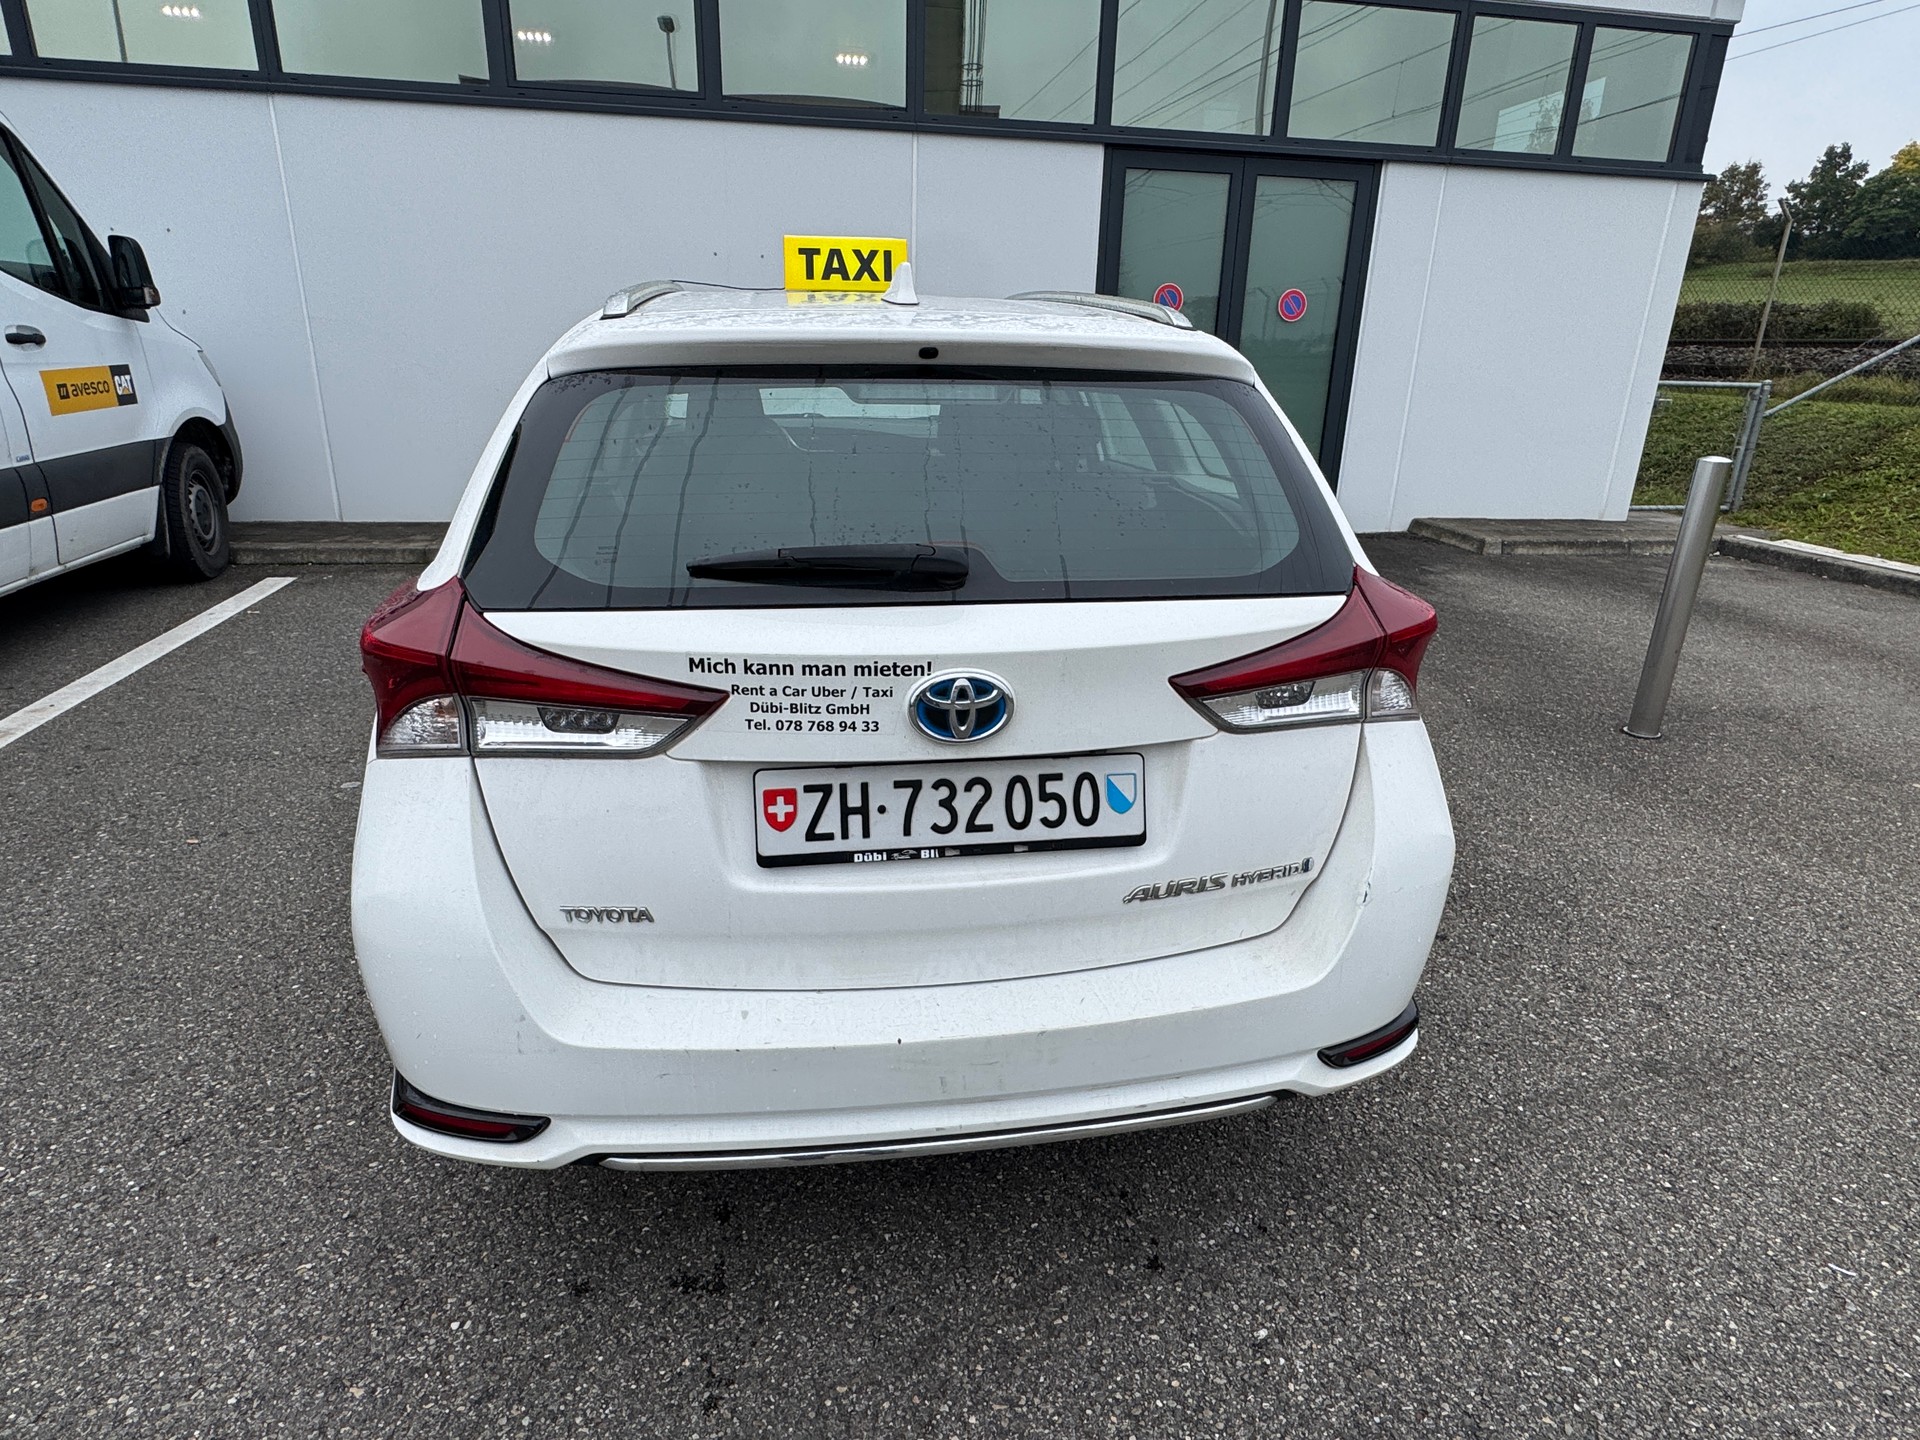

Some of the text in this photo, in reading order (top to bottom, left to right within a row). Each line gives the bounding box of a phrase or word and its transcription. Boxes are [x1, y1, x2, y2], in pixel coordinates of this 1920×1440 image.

[798, 248, 892, 282] TAXI
[70, 375, 133, 398] avesco CAT
[688, 657, 933, 677] Mich kann man mieten!
[730, 684, 894, 700] Rent a Car Uber / Taxi
[750, 702, 871, 715] Dübi-Blitz GmbH
[745, 719, 880, 732] Tel. 078 768 94 33
[853, 852, 887, 863] Dübi
[1123, 862, 1304, 904] AURIS HYBRID
[560, 906, 655, 923] TOYOTA
